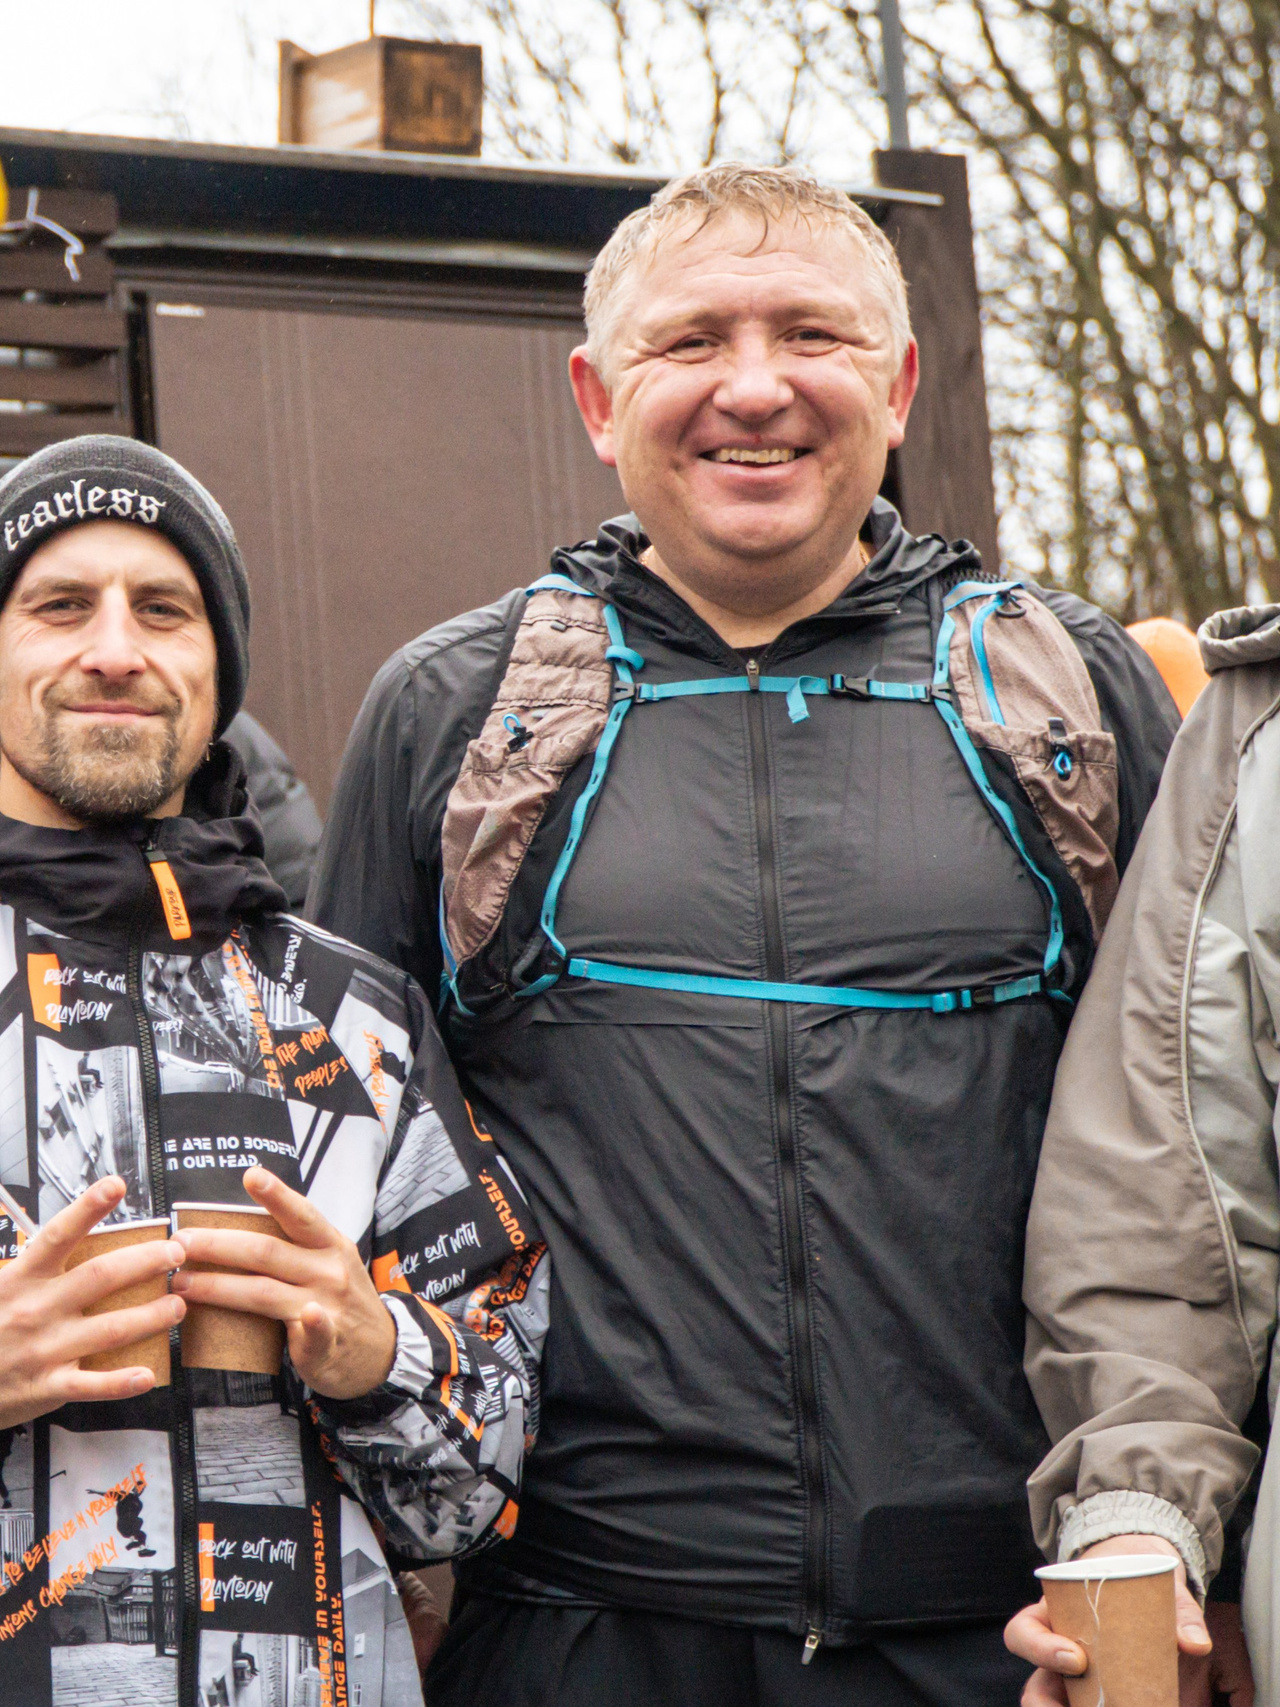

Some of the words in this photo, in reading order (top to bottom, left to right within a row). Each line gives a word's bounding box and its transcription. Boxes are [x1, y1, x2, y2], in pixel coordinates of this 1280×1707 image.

[3, 478, 167, 551] fearless
[181, 1137, 212, 1151] ARE
[216, 1136, 240, 1150] NO
[183, 1155, 216, 1169] OUR
[3, 1560, 25, 1586] TO
[23, 1517, 78, 1572] BELIEVE
[241, 1536, 271, 1563] OUT
[269, 1538, 298, 1571] WITH
